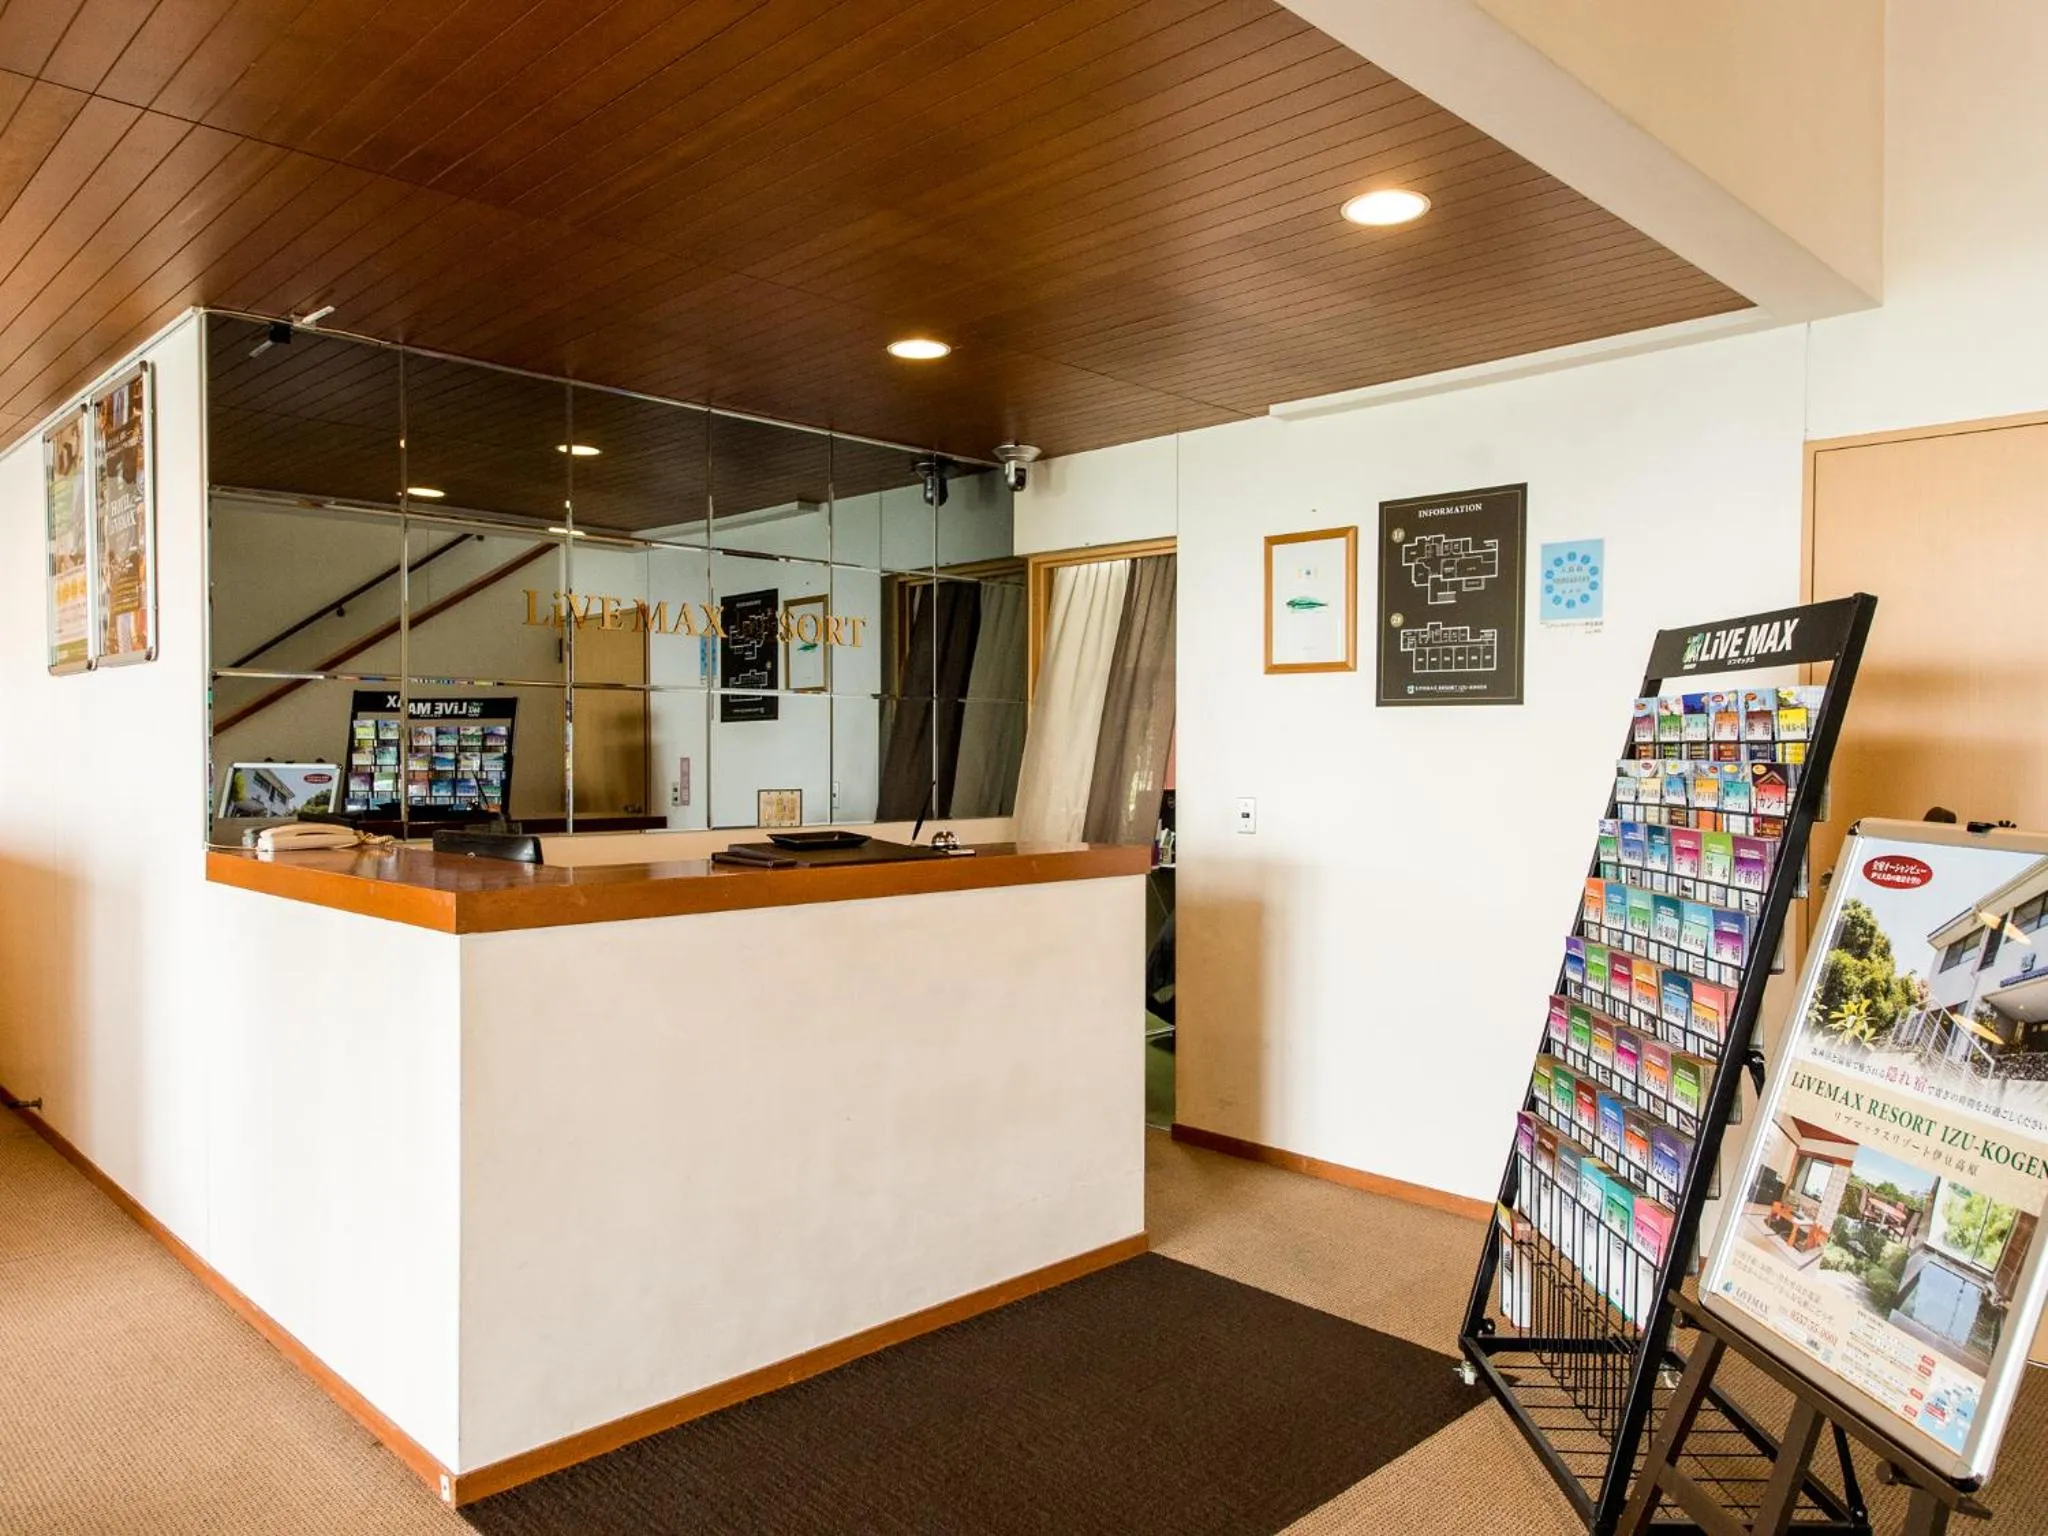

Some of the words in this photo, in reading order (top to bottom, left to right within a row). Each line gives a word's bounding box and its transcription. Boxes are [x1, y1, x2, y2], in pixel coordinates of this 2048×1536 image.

[1418, 503, 1483, 519] INFORMATION
[522, 589, 624, 630] LiVE
[631, 597, 729, 638] MAX
[1699, 626, 1746, 662] LiVE
[1743, 617, 1800, 656] MAX
[1867, 1097, 1937, 1138] RESORT
